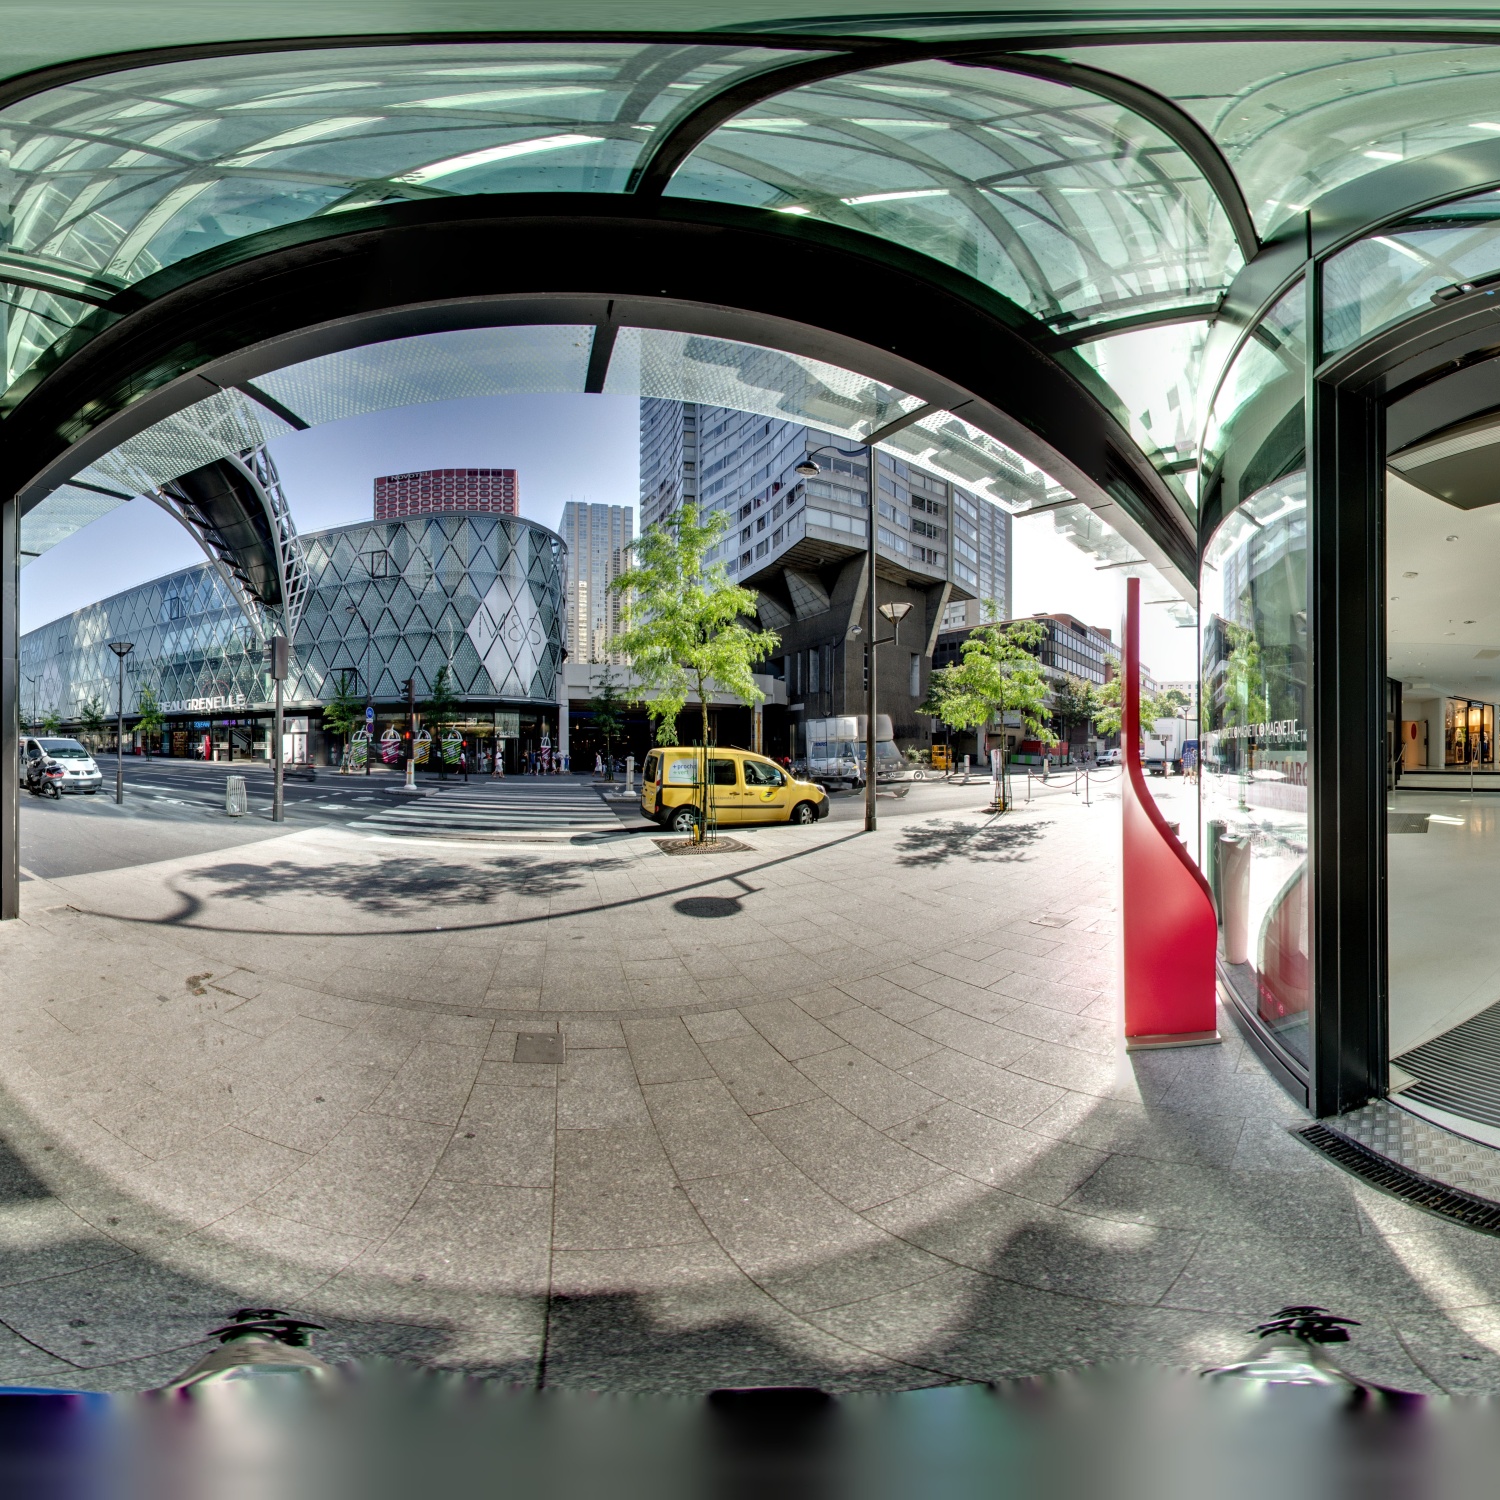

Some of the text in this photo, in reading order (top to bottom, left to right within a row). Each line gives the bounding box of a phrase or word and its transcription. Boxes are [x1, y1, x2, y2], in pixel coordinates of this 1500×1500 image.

[479, 610, 541, 645] M&S
[157, 694, 246, 713] BEAUGRENELLE
[1265, 719, 1298, 736] MAGNETIC
